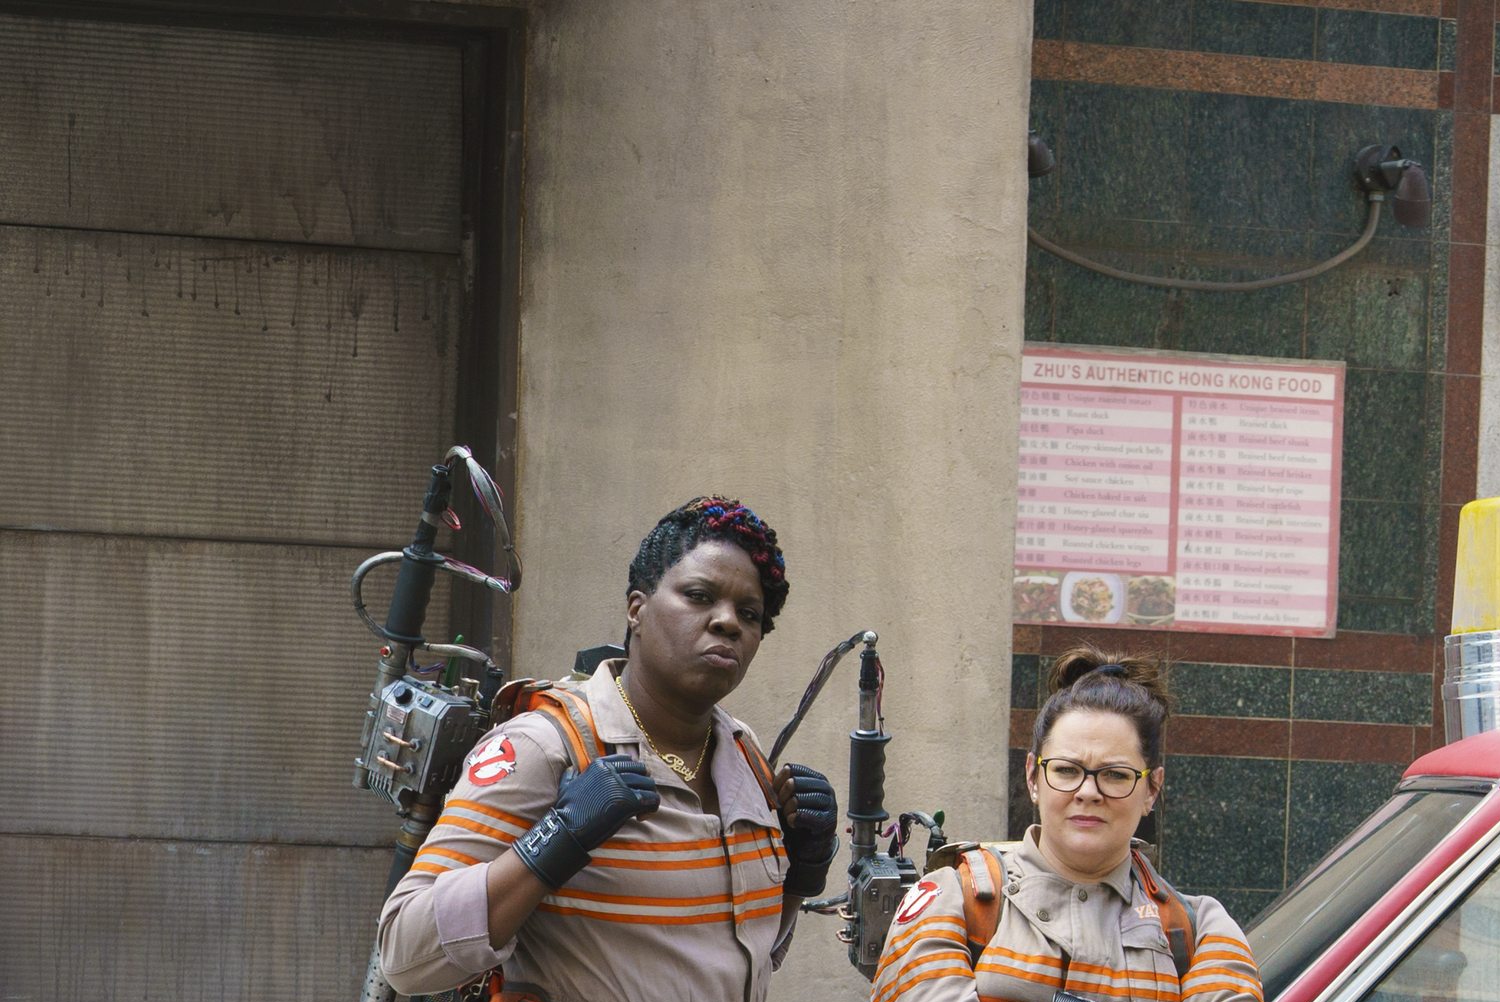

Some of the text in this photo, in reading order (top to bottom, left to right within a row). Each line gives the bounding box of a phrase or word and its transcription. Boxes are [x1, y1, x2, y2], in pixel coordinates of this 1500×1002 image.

[1033, 363, 1322, 394] ZHU'S AUTHENTIC HONG KONG FOOD
[1067, 393, 1095, 404] Unique
[1066, 409, 1109, 420] Roast duck
[1240, 403, 1320, 416] Unique braised items
[1239, 419, 1287, 430] Braised duck
[1066, 425, 1104, 437] Pipa duck
[1238, 435, 1267, 445] Braised
[1269, 436, 1286, 446] beef
[1126, 445, 1143, 456] pork
[1145, 445, 1164, 457] belly
[1238, 451, 1317, 463] Braised beef tendons
[1064, 457, 1153, 471] Chicken with onion oil
[1237, 467, 1312, 480] Braised beef brisket
[1064, 474, 1134, 486] Soy sauce chicken
[1237, 483, 1265, 493] Braised
[1267, 484, 1283, 494] beef
[1064, 490, 1147, 503] Chicken baked in salt
[1236, 499, 1265, 509] Braised
[1063, 506, 1149, 519] Honey-glazed char siu
[1235, 515, 1322, 528] Braised pork intestines
[1063, 523, 1153, 536] Honey-glazed spareribs
[1235, 531, 1263, 541] Braised
[1265, 532, 1283, 544] pork
[1062, 539, 1150, 552] Roasted chicken wings
[1234, 547, 1263, 557] Braised
[1265, 549, 1277, 559] pig
[1061, 555, 1142, 568] Roasted chicken legs
[1233, 564, 1262, 574] Braised
[1264, 565, 1282, 575] pork
[1233, 579, 1293, 592] Braised sausage
[1232, 596, 1261, 606] Braised
[1232, 611, 1300, 623] Braised duck liver
[1134, 903, 1160, 919] YA
